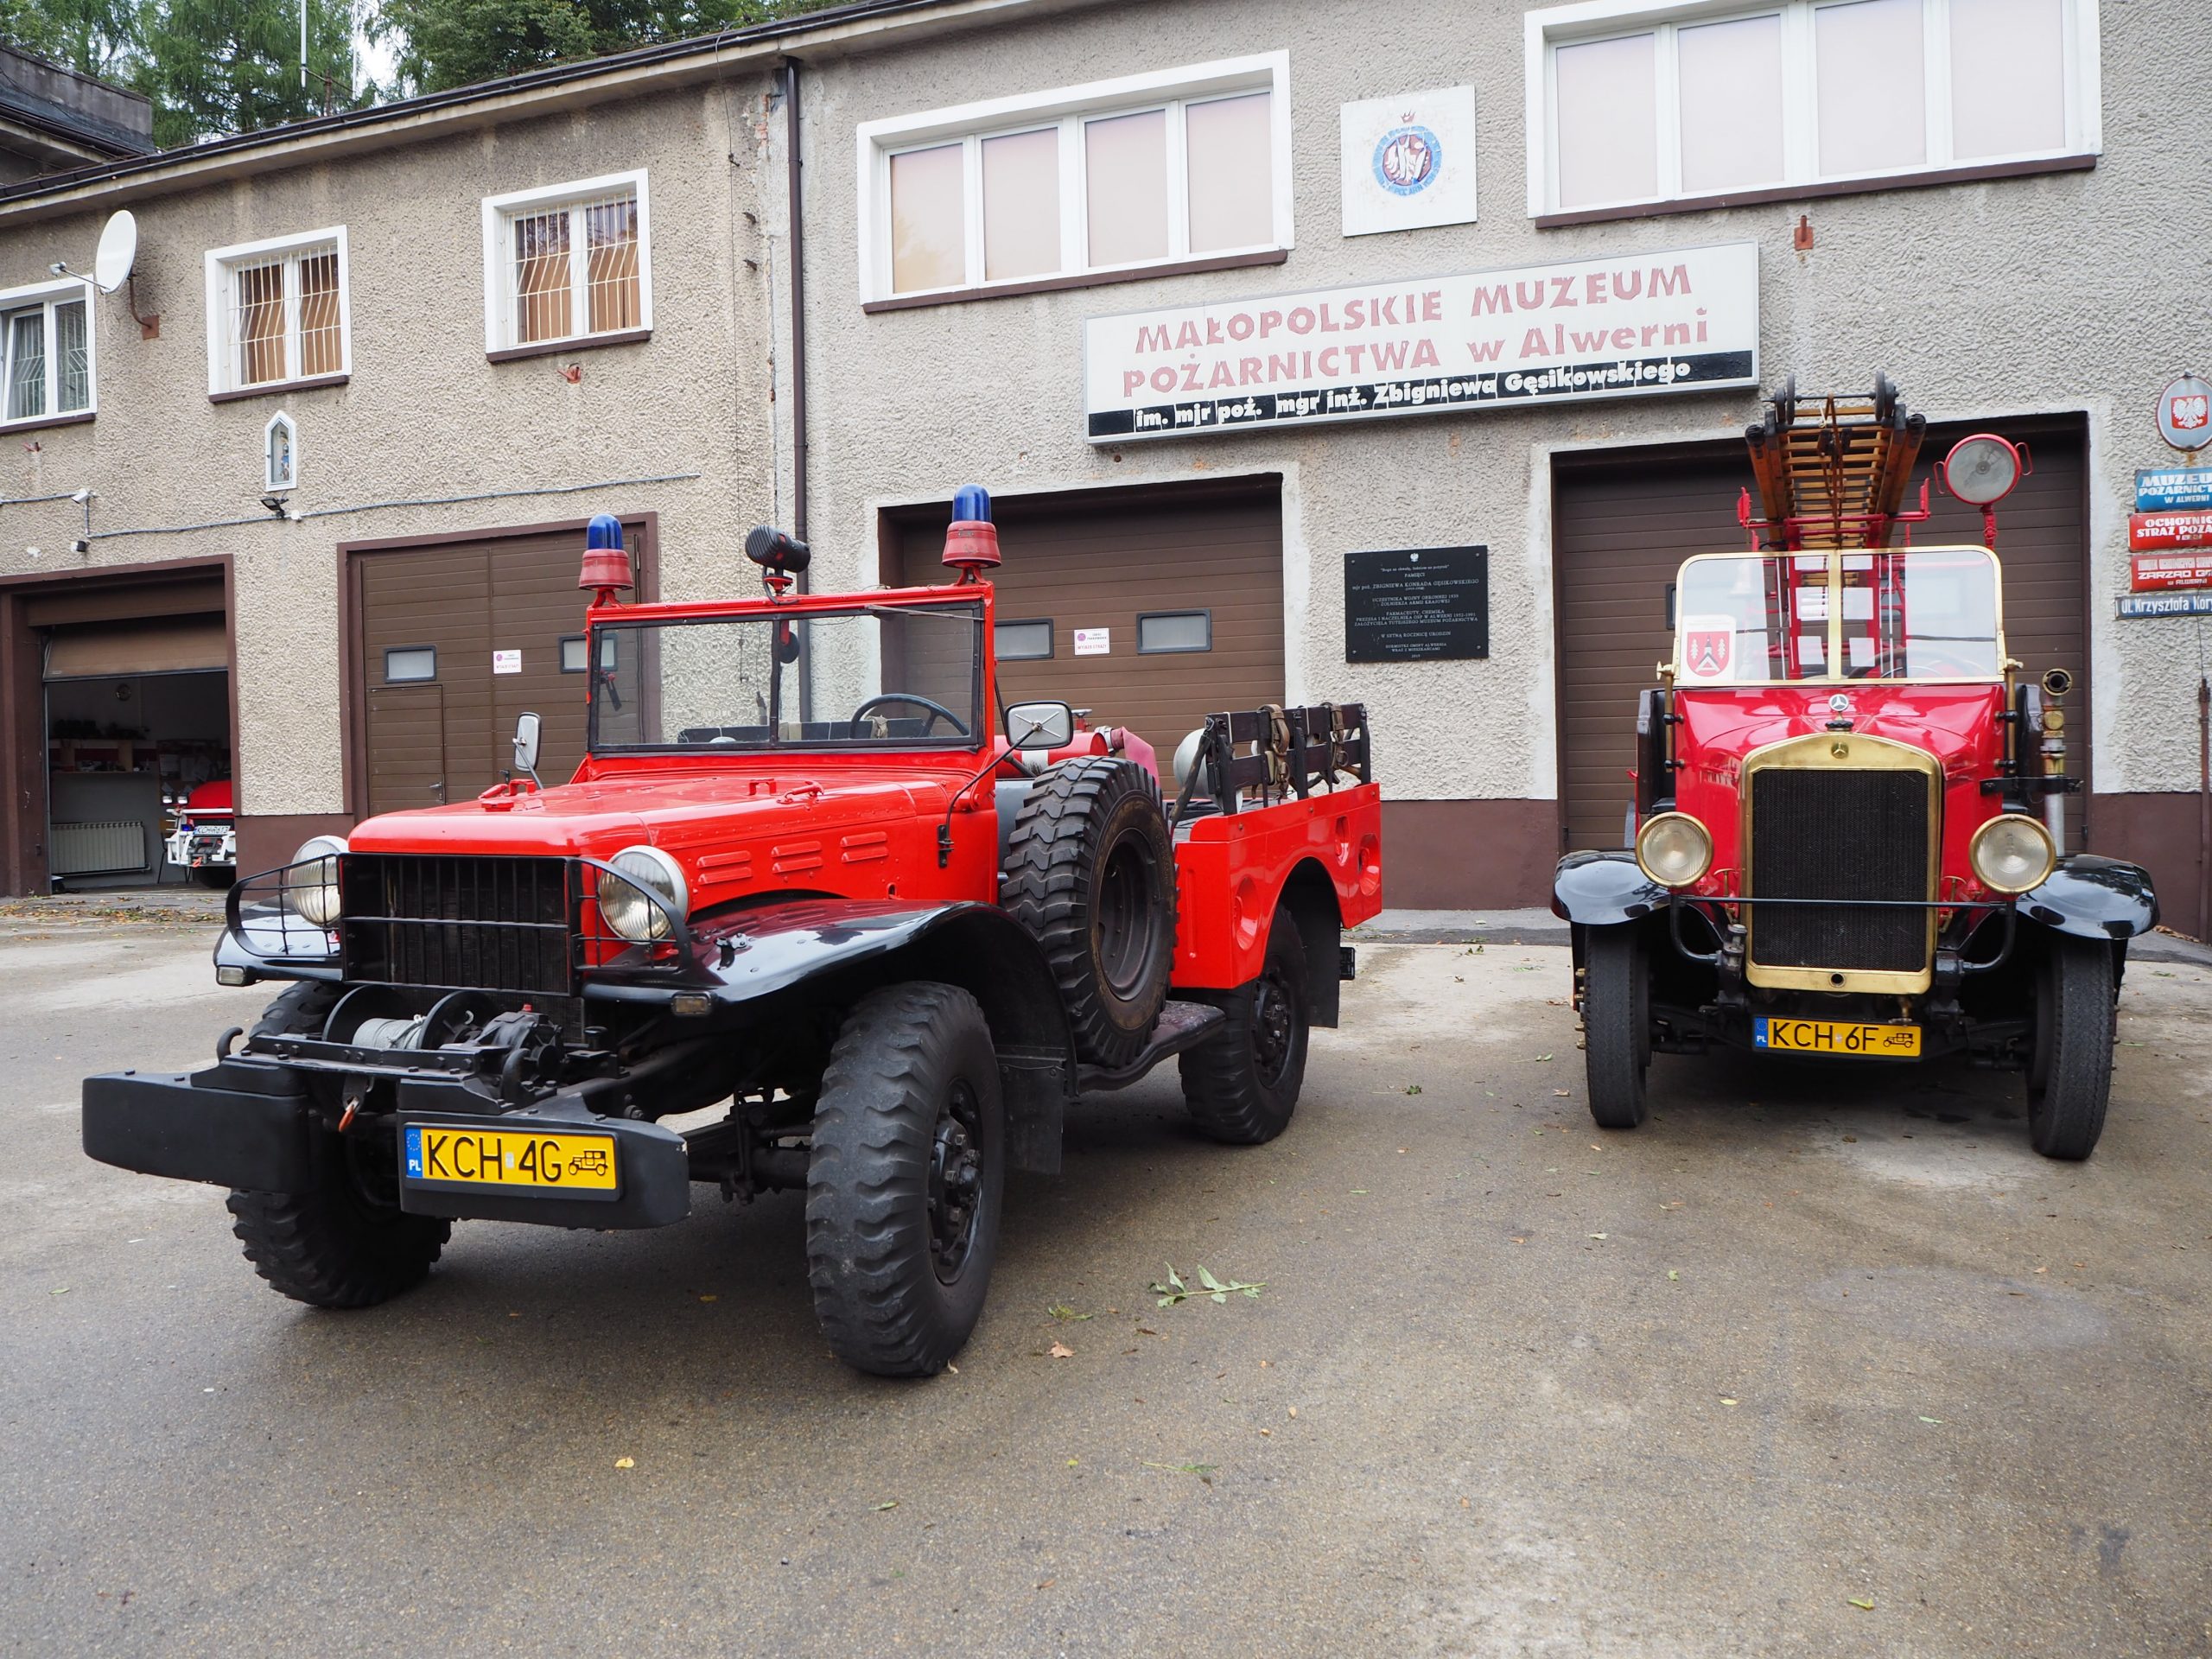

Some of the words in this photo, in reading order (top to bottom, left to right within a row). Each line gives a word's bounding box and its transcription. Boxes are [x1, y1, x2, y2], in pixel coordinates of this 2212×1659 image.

[1135, 289, 1442, 353] MAŁOPOLSKIE
[1471, 264, 1692, 317] MUZEUM
[1123, 338, 1440, 397] POŻARNICTWA
[1466, 338, 1505, 363] w
[1518, 306, 1707, 359] Alwerni
[1136, 409, 1168, 428] im.
[1175, 403, 1211, 427] mjr
[1217, 396, 1262, 423] poż.
[1276, 394, 1319, 416] mgr
[1327, 385, 1368, 407] inż.
[1374, 376, 1497, 404] Zbigniewa
[1505, 360, 1691, 394] Gęsikowskiego
[2134, 596, 2190, 614] Krzysztofa
[1757, 1034, 1767, 1043] PL
[1773, 1021, 1834, 1049] KCH
[1845, 1026, 1879, 1051] 6F
[409, 1159, 422, 1172] PL
[428, 1135, 503, 1180] KCH
[518, 1139, 563, 1183] 4G
